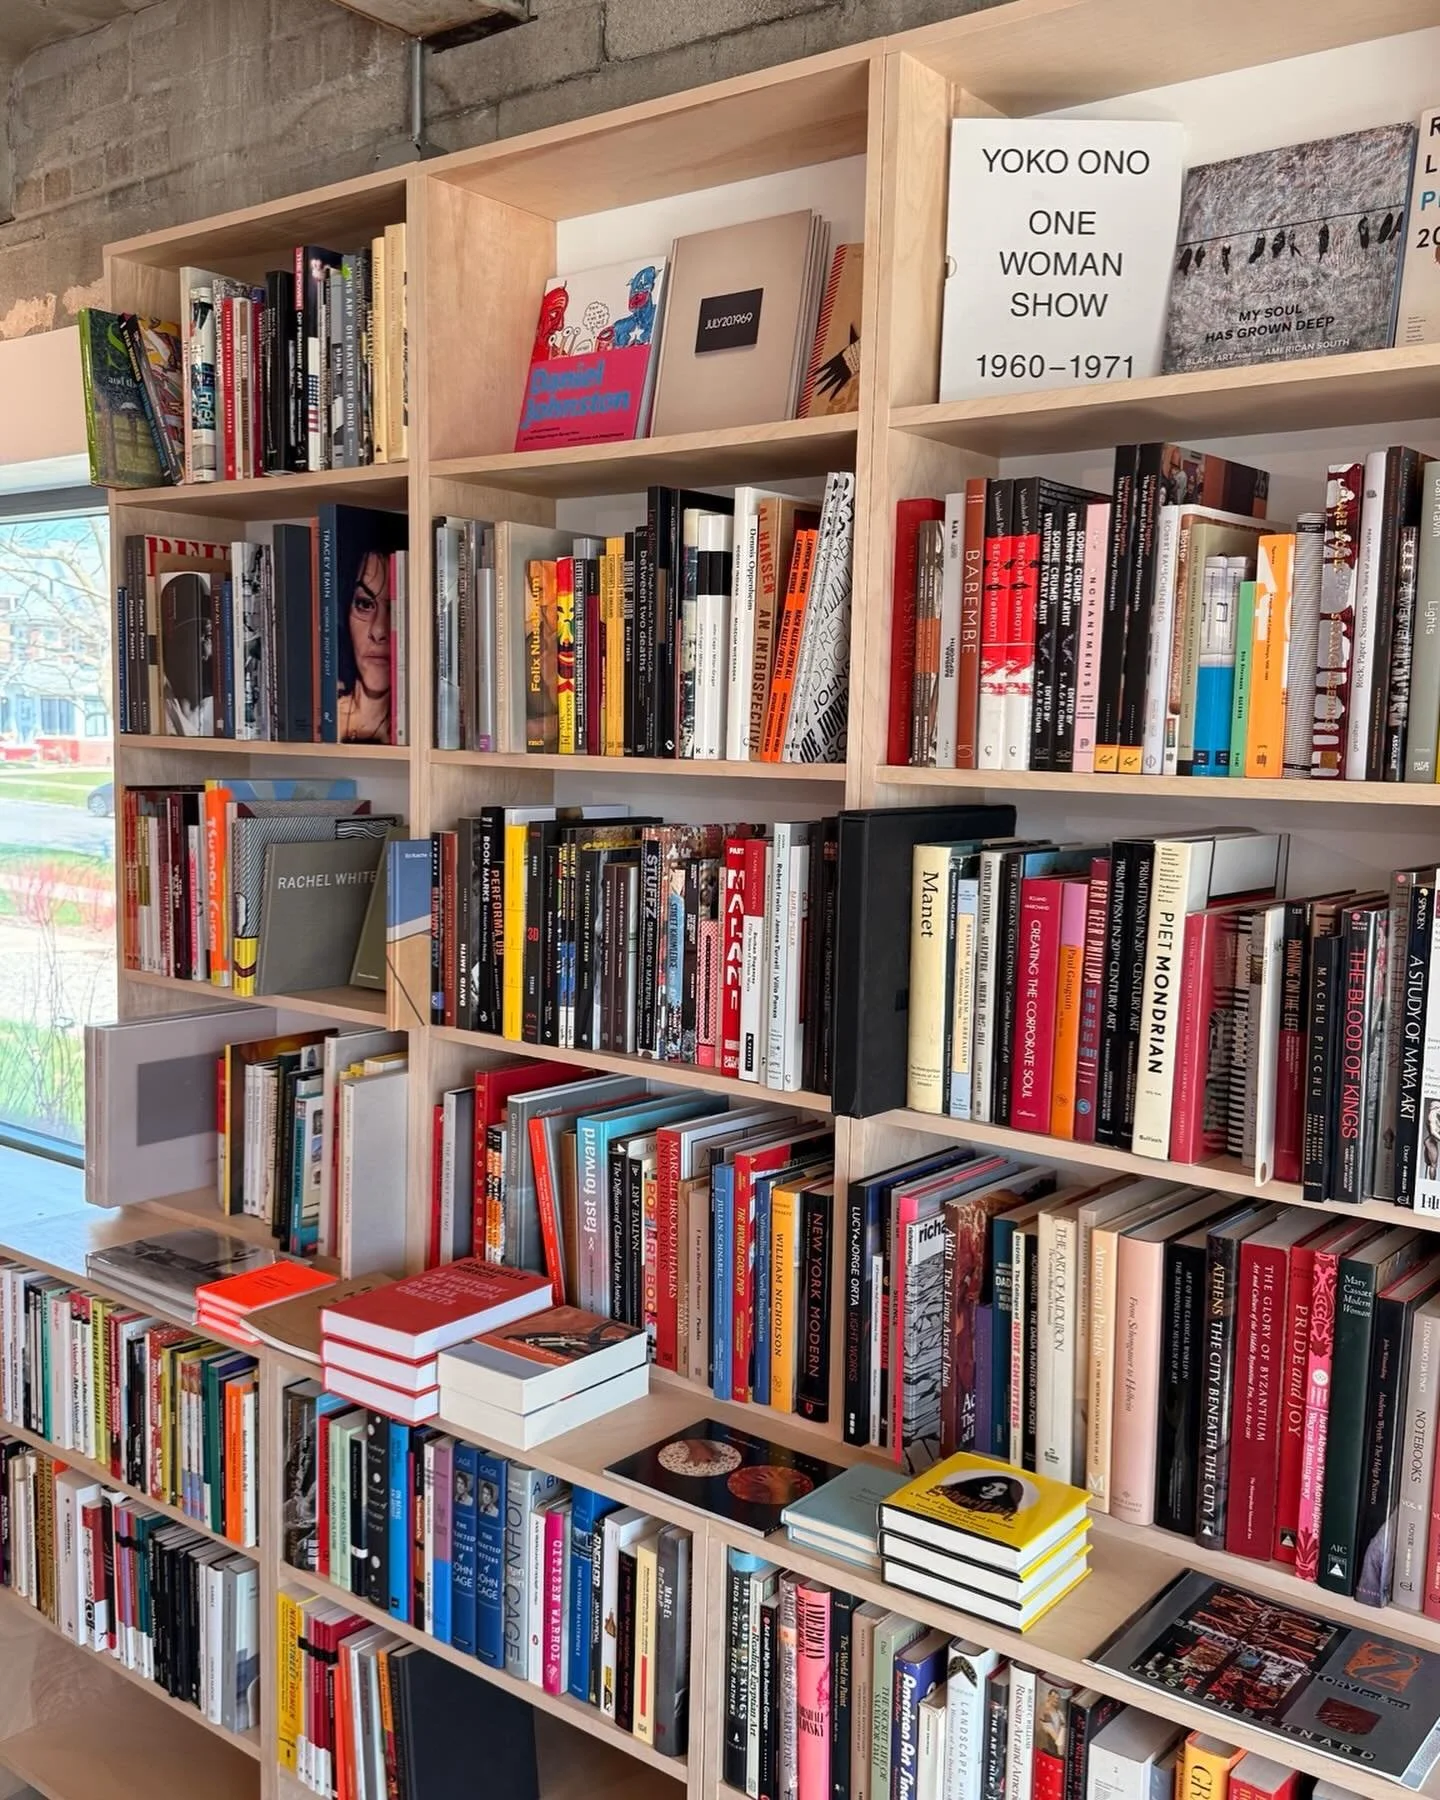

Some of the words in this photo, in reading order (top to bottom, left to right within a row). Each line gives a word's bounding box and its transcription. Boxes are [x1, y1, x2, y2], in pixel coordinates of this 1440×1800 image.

[982, 148, 1068, 174] YOKO
[1077, 148, 1150, 175] ONO
[1028, 210, 1097, 235] ONE
[999, 251, 1122, 277] WOMAN
[296, 311, 303, 323] OF
[345, 298, 353, 317] ARP
[1010, 292, 1108, 318] SHOW
[1238, 307, 1260, 323] MY
[1263, 304, 1303, 321] SOUL
[346, 324, 354, 342] DIE
[1205, 330, 1234, 344] HAS
[1237, 322, 1292, 339] GROWN
[1296, 316, 1335, 331] DEEP
[346, 344, 354, 376] NATUR
[1185, 357, 1214, 366] BLACK
[1216, 354, 1234, 362] ART
[1265, 342, 1315, 356] AMERICAN
[1316, 338, 1350, 349] SOUTH
[346, 380, 355, 400] DER
[530, 360, 605, 395] Daniel
[347, 403, 355, 433] DINGE
[521, 389, 631, 430] Johnston
[758, 507, 768, 521] AL
[323, 529, 331, 569] TRACEY
[748, 528, 757, 558] Dennis
[1051, 530, 1061, 565] SOPHIE
[624, 560, 634, 592] DONALD
[639, 550, 648, 603] between
[759, 532, 775, 595] HANSEN
[323, 572, 331, 598] EMIN
[747, 560, 756, 611] Oppenheim
[624, 598, 633, 620] JUDD
[639, 606, 647, 627] two
[960, 550, 980, 654] BABEMBE
[1424, 600, 1438, 635] Lights
[759, 610, 772, 630] AN
[638, 631, 648, 672] deaths
[530, 660, 542, 692] Felix
[748, 636, 769, 753] INTROSPECTIVE
[482, 836, 491, 865] BOOK
[277, 873, 332, 890] RACHEL
[334, 870, 378, 886] WHITE
[482, 867, 490, 902] MARKS
[645, 854, 658, 919] STUFFZ
[774, 863, 783, 890] Robert
[1009, 863, 1018, 879] THE
[490, 870, 503, 937] PERFORMA
[774, 891, 782, 912] Irwin
[921, 871, 939, 938] Manet
[1008, 881, 1017, 925] AMERICAN
[1090, 879, 1109, 904] BERT
[1087, 909, 1106, 936] GEER
[1415, 897, 1428, 930] SPINDEN
[646, 921, 654, 953] DESIGN
[773, 919, 782, 944] James
[1158, 911, 1175, 950] PIET
[646, 955, 654, 967] ON
[773, 945, 781, 970] Turrell
[1005, 928, 1014, 985] COLLECTIONS
[1027, 920, 1041, 975] CREATING
[1066, 948, 1077, 969] Paul
[1084, 939, 1104, 985] PHILLIPS
[1409, 955, 1424, 968] A
[1348, 948, 1367, 984] THE
[644, 969, 654, 1010] MATERIAL
[772, 976, 780, 993] Villa
[1027, 979, 1038, 997] THE
[1063, 970, 1074, 1010] Gauguin
[1314, 967, 1327, 1024] MACHU
[1406, 970, 1423, 1019] STUDY
[771, 994, 779, 1018] Panza
[1147, 955, 1171, 1074] MONDRIAN
[1344, 988, 1365, 1051] BLOOD
[1023, 1000, 1038, 1066] CORPORATE
[1406, 1022, 1421, 1043] OF
[1312, 1036, 1324, 1097] PICCHU
[1344, 1055, 1360, 1079] OF
[1402, 1047, 1418, 1090] MAYA
[1022, 1069, 1034, 1099] SOUL
[1341, 1084, 1359, 1138] KINGS
[1400, 1092, 1416, 1122] ART
[583, 1127, 596, 1194] forward
[668, 1140, 679, 1194] MARCEL
[631, 1183, 640, 1206] ART
[645, 1182, 656, 1220] POP
[584, 1200, 596, 1233] fast
[631, 1209, 640, 1250] NATIVE
[645, 1231, 656, 1263] ART
[667, 1199, 678, 1298] BROODTHAERS
[811, 1213, 823, 1253] NEW
[944, 1228, 957, 1261] Aditi
[775, 1233, 783, 1284] WILLIAM
[810, 1258, 822, 1298] YORK
[849, 1278, 860, 1306] ORTA
[944, 1268, 954, 1287] The
[1092, 1244, 1108, 1309] American
[1211, 1262, 1225, 1315] ATHENS
[1262, 1265, 1274, 1293] THE
[645, 1273, 656, 1325] BOOK
[943, 1290, 953, 1323] Living
[774, 1288, 783, 1357] NICHOLSON
[848, 1312, 859, 1341] LIGHT
[1261, 1297, 1273, 1338] GLORY
[808, 1307, 821, 1378] MODERN
[943, 1327, 953, 1347] Arts
[1092, 1313, 1106, 1360] Pastels
[1209, 1321, 1223, 1349] THE
[1292, 1304, 1308, 1365] PRIDE
[847, 1345, 858, 1382] WORKS
[943, 1348, 953, 1358] of
[1207, 1351, 1222, 1385] CITY
[1261, 1343, 1272, 1361] OF
[942, 1360, 952, 1387] India
[1289, 1368, 1305, 1399] and
[1205, 1387, 1220, 1450] BENEATH
[1256, 1366, 1270, 1441] BYZANTIUM
[1287, 1402, 1302, 1436] JOY
[1410, 1409, 1426, 1483] NOTEBOOKS
[1203, 1451, 1217, 1481] THE
[1202, 1483, 1216, 1517] CITY
[505, 1488, 522, 1570] JOHN
[551, 1540, 562, 1602] CITIZEN
[732, 1576, 740, 1602] LINDA
[505, 1583, 520, 1662] CAGE
[550, 1608, 561, 1661] WARHOL
[731, 1606, 739, 1636] SCHELE
[749, 1632, 759, 1673] Reading
[840, 1635, 848, 1650] The
[730, 1647, 738, 1674] PETER
[763, 1652, 771, 1668] Myth
[839, 1652, 848, 1678] World
[729, 1677, 737, 1716] MATHEWS
[748, 1675, 758, 1717] Egyptian
[839, 1686, 848, 1707] Paint
[881, 1686, 890, 1704] THE
[1128, 1663, 1239, 1713] JOSEPH
[880, 1706, 890, 1738] SECRET
[900, 1672, 917, 1741] American
[749, 1719, 757, 1737] Art
[880, 1743, 889, 1765] LIFE
[900, 1741, 917, 1766] Art
[879, 1767, 888, 1782] OF
